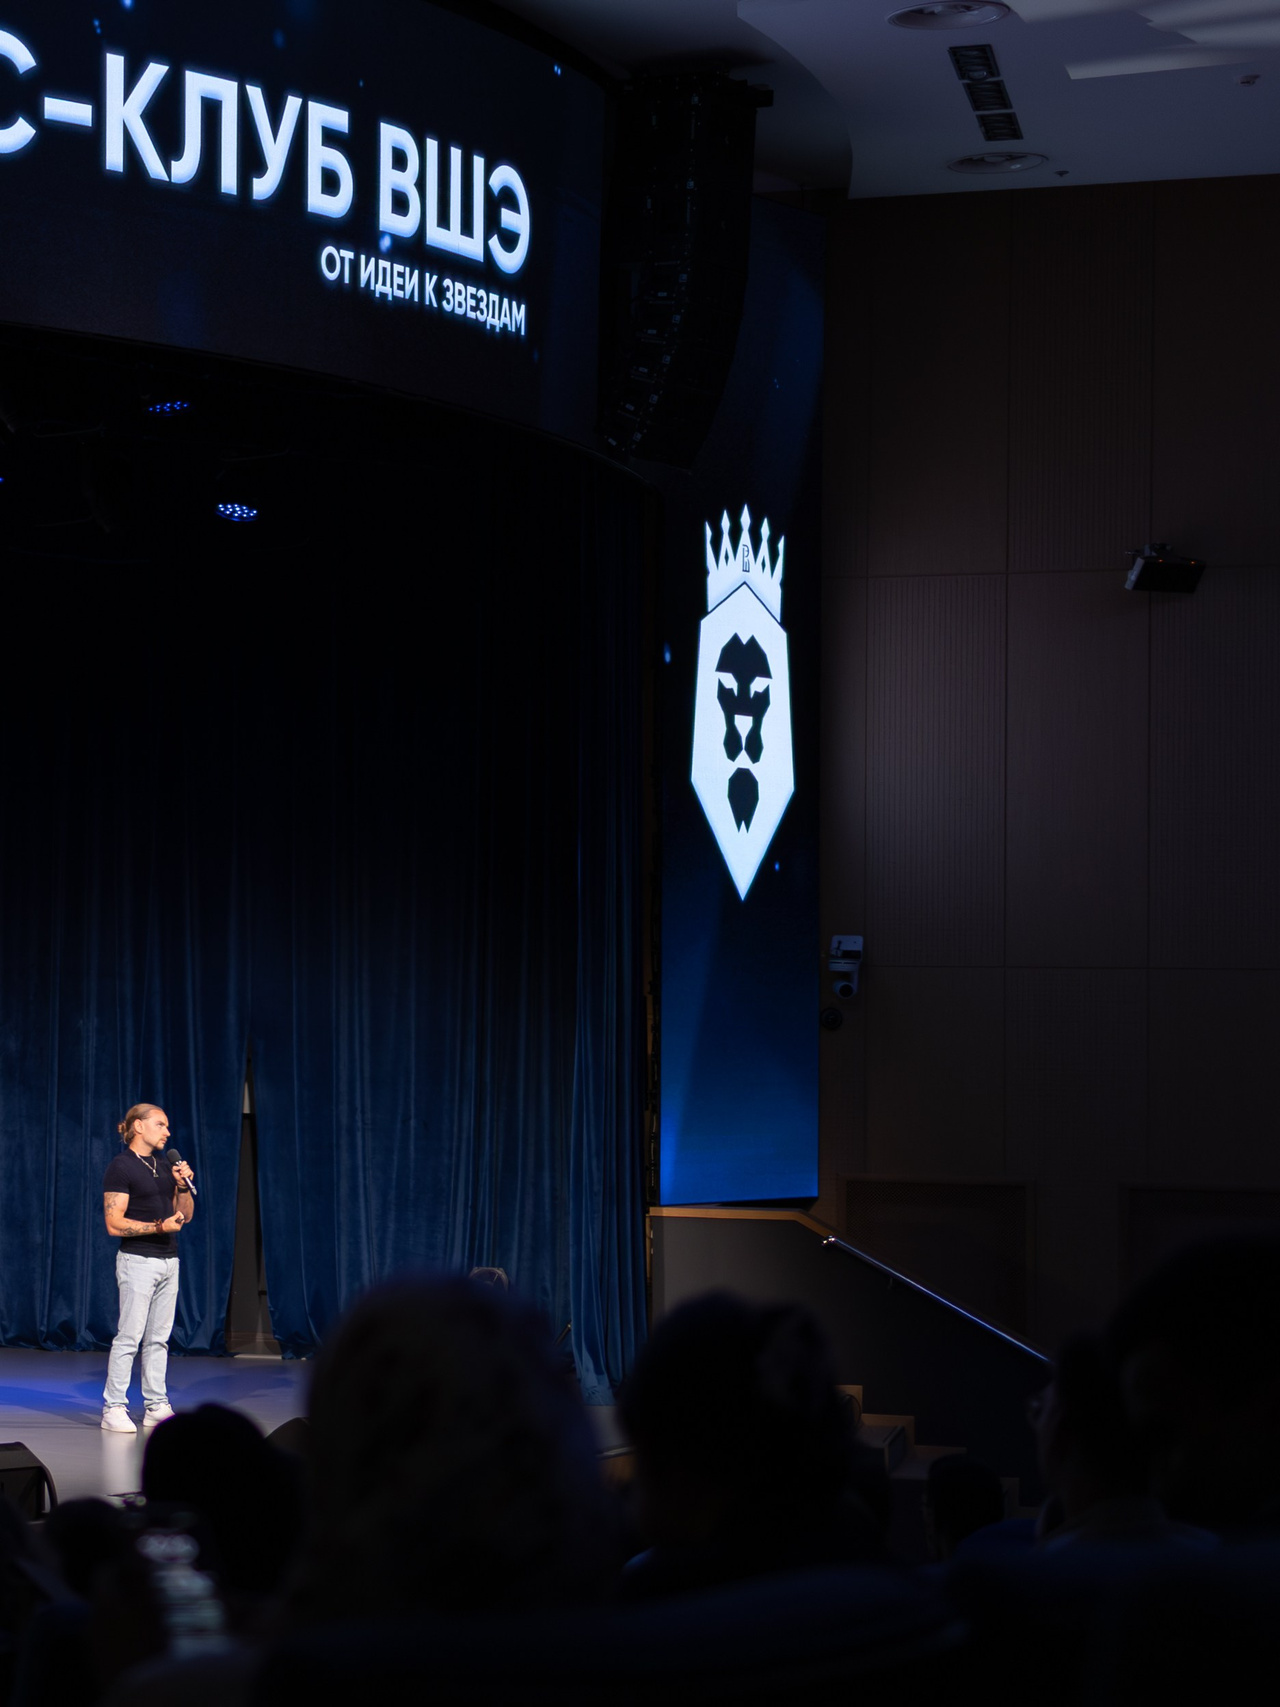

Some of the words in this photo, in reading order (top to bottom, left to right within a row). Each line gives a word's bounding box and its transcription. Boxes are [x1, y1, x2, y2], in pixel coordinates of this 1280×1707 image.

[379, 121, 530, 274] ВШЭ
[320, 245, 355, 284] ОТ
[360, 254, 419, 302] ИДЕИ
[425, 272, 438, 308] К
[442, 278, 526, 336] ЗВЕЗДАМ
